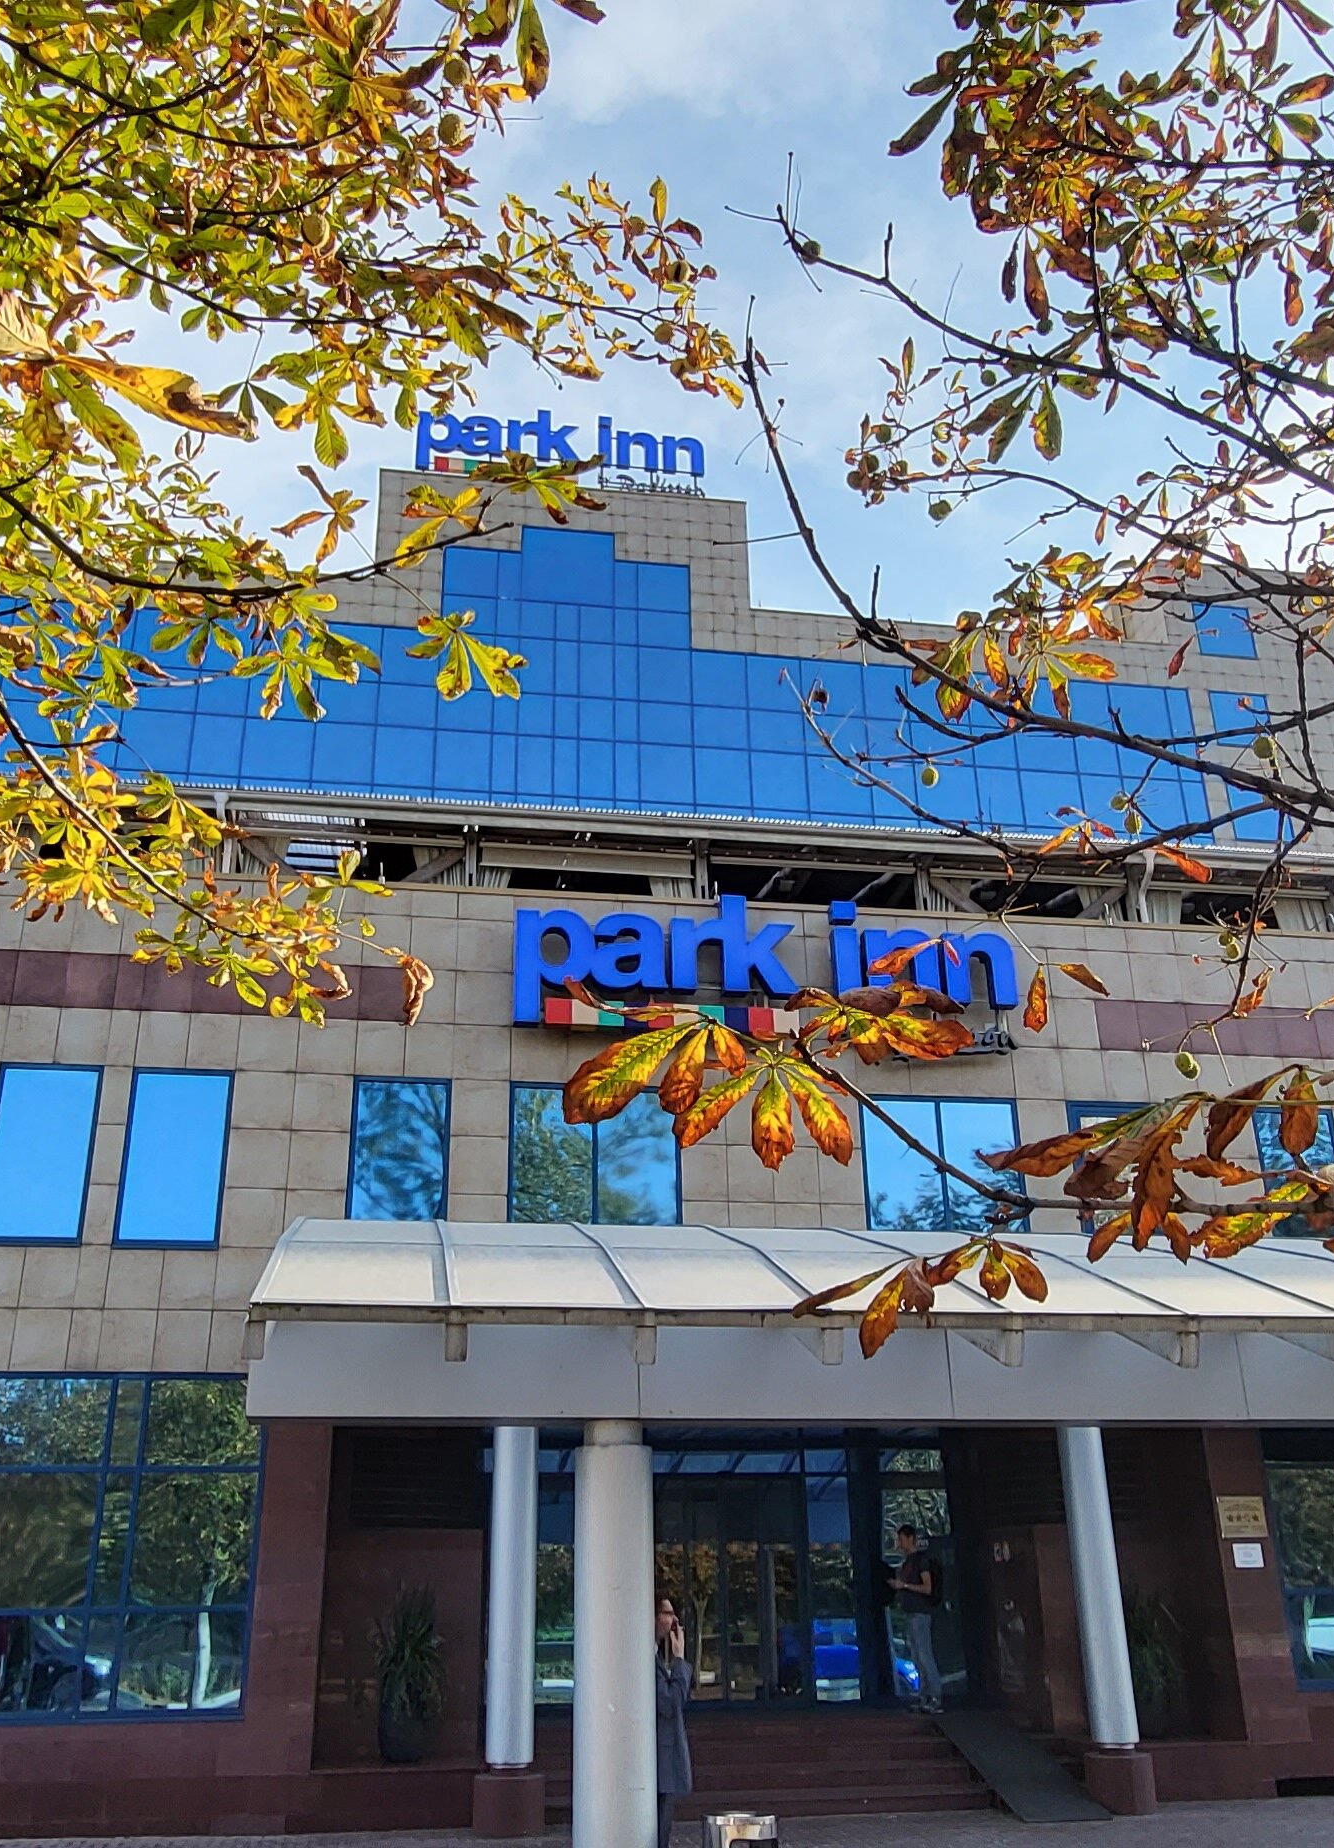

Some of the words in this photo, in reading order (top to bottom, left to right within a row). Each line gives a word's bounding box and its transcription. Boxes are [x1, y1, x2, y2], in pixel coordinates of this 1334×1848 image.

[416, 409, 579, 471] park
[597, 415, 705, 478] inn
[514, 894, 800, 1027] park
[829, 900, 1019, 1010] inn
